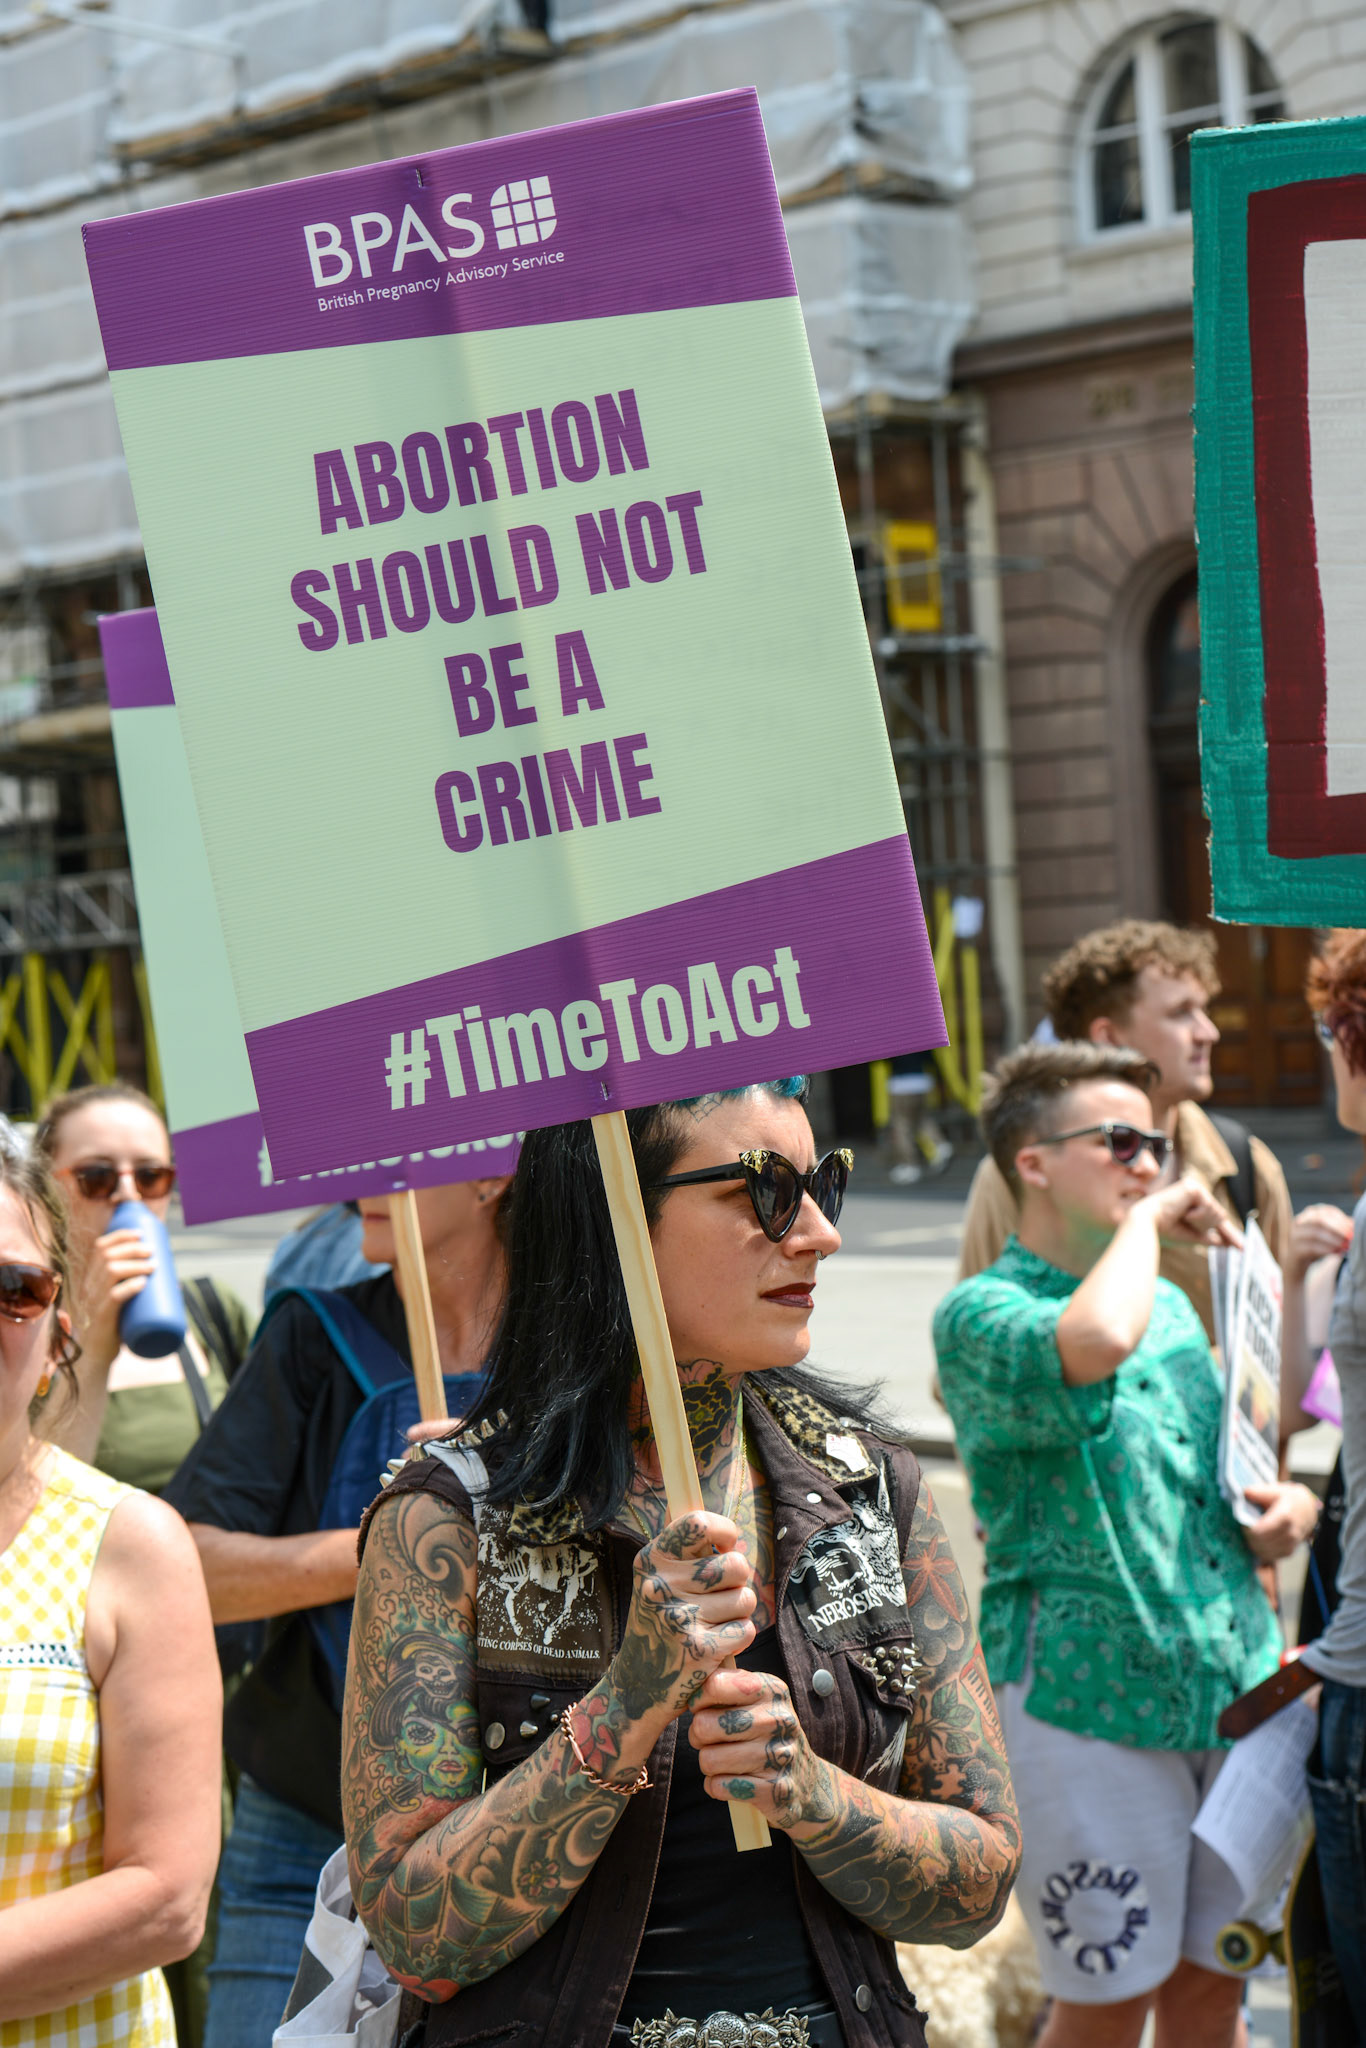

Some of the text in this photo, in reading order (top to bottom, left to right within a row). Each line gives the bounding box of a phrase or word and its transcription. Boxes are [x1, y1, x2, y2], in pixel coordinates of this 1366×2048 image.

[303, 192, 485, 289] BPAS
[317, 251, 565, 312] British Pregnancy Advisory Service
[313, 388, 650, 535] ABORTION
[290, 490, 707, 652] SHOULD NOT
[444, 630, 606, 737] BE A
[434, 732, 662, 853] CRIME
[384, 946, 811, 1110] #TimeToAct
[499, 1640, 533, 1652] CORPSES
[533, 1643, 543, 1654] OF
[543, 1645, 565, 1659] DEAD
